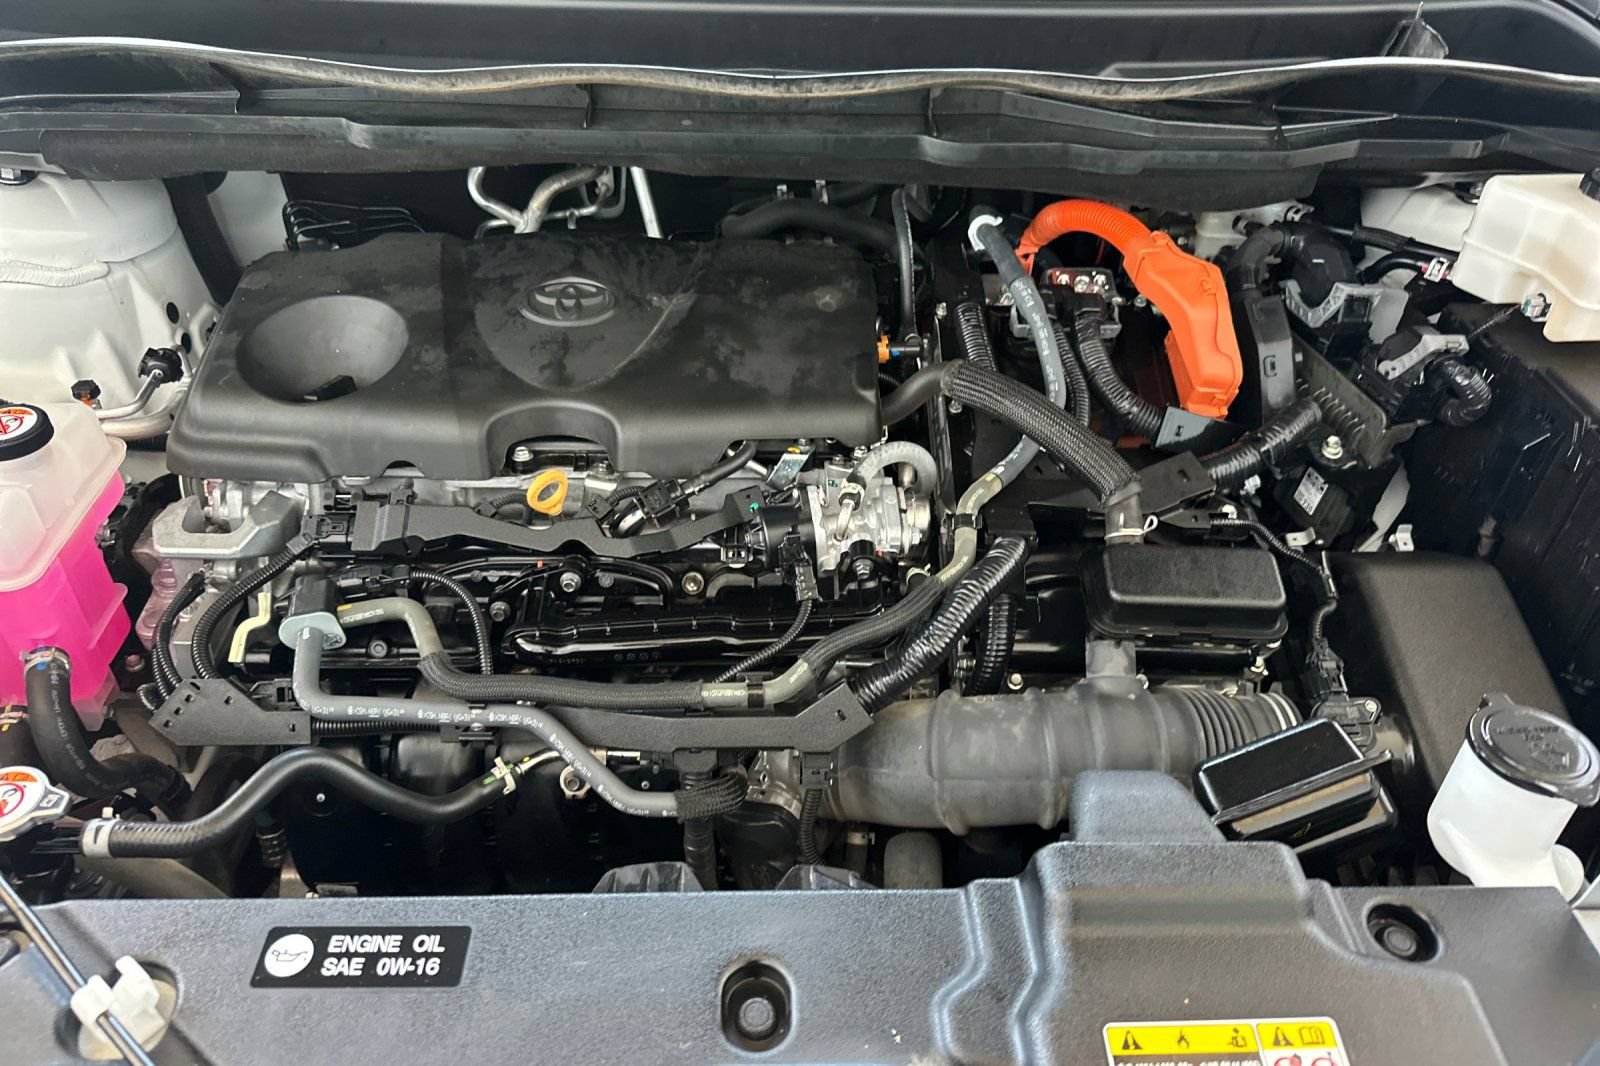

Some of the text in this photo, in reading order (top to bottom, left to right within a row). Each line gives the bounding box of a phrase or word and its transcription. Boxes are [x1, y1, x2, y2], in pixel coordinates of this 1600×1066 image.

[327, 934, 446, 953] ENGINE OIL
[320, 957, 441, 977] SAE 0W-16
